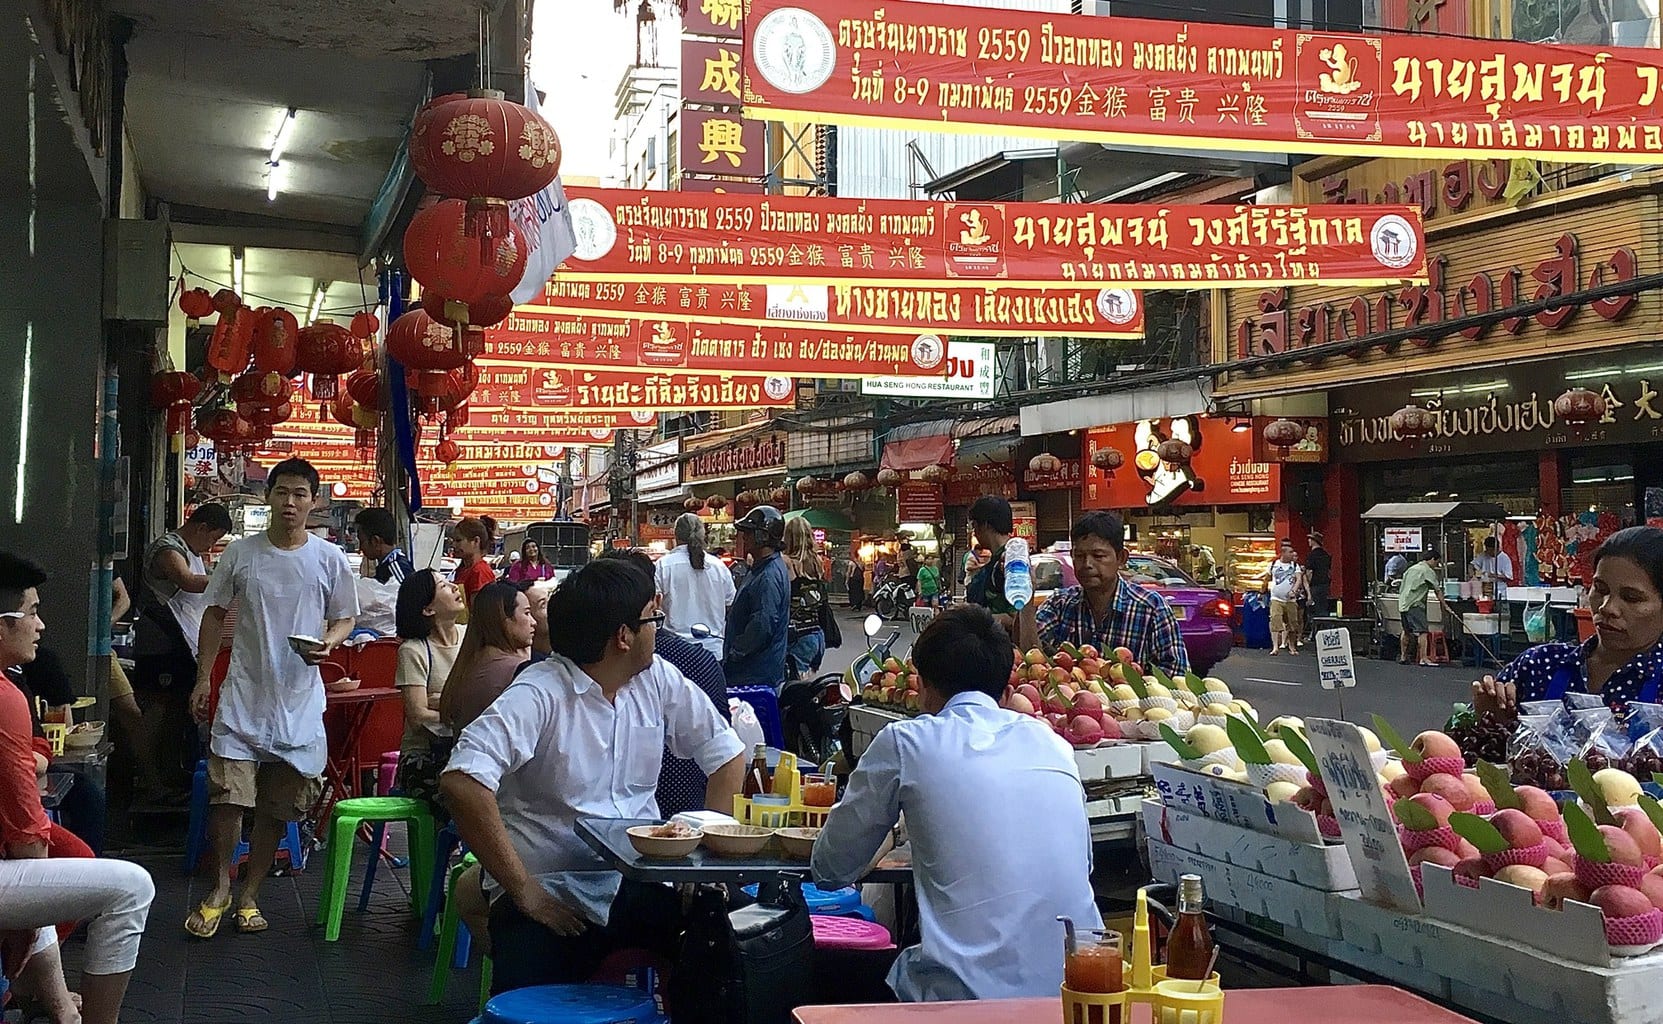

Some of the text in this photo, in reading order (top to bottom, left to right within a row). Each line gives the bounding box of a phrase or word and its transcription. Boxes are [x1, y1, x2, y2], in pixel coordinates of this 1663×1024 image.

[838, 6, 1284, 84] ตรุษจีนเยาวราช 2559 ปีวอกทอง มงคลยิ่ง ลาภพูนทวี
[851, 62, 885, 104] วันที่
[892, 76, 930, 105] 8-9
[938, 73, 1014, 121] กุมภาพันธ์
[1023, 86, 1072, 116] 2559
[1074, 82, 1128, 118] 金猴
[1148, 86, 1200, 124] 富贵
[1216, 92, 1278, 126] 兴隆
[1391, 52, 1613, 120] นายสุพจน์
[616, 196, 708, 231] ตรุษจีนเยาวราช
[715, 207, 753, 231] 2559
[760, 201, 820, 233] ปีวอกทอง
[826, 200, 873, 235] มงคลยิ่ง
[1013, 208, 1170, 260] นายสุพจน์
[658, 243, 683, 264] 8-9
[750, 246, 785, 266] 2559
[838, 243, 875, 269] 富贵
[889, 246, 927, 269] 兴隆
[1061, 252, 1320, 281] นายกสมาคมค้าข้าวไทย
[596, 282, 625, 301] 2559
[633, 283, 667, 306] 金猴
[498, 341, 522, 355] 2559
[866, 380, 974, 392] HUA SENG HONG RESTAURANT
